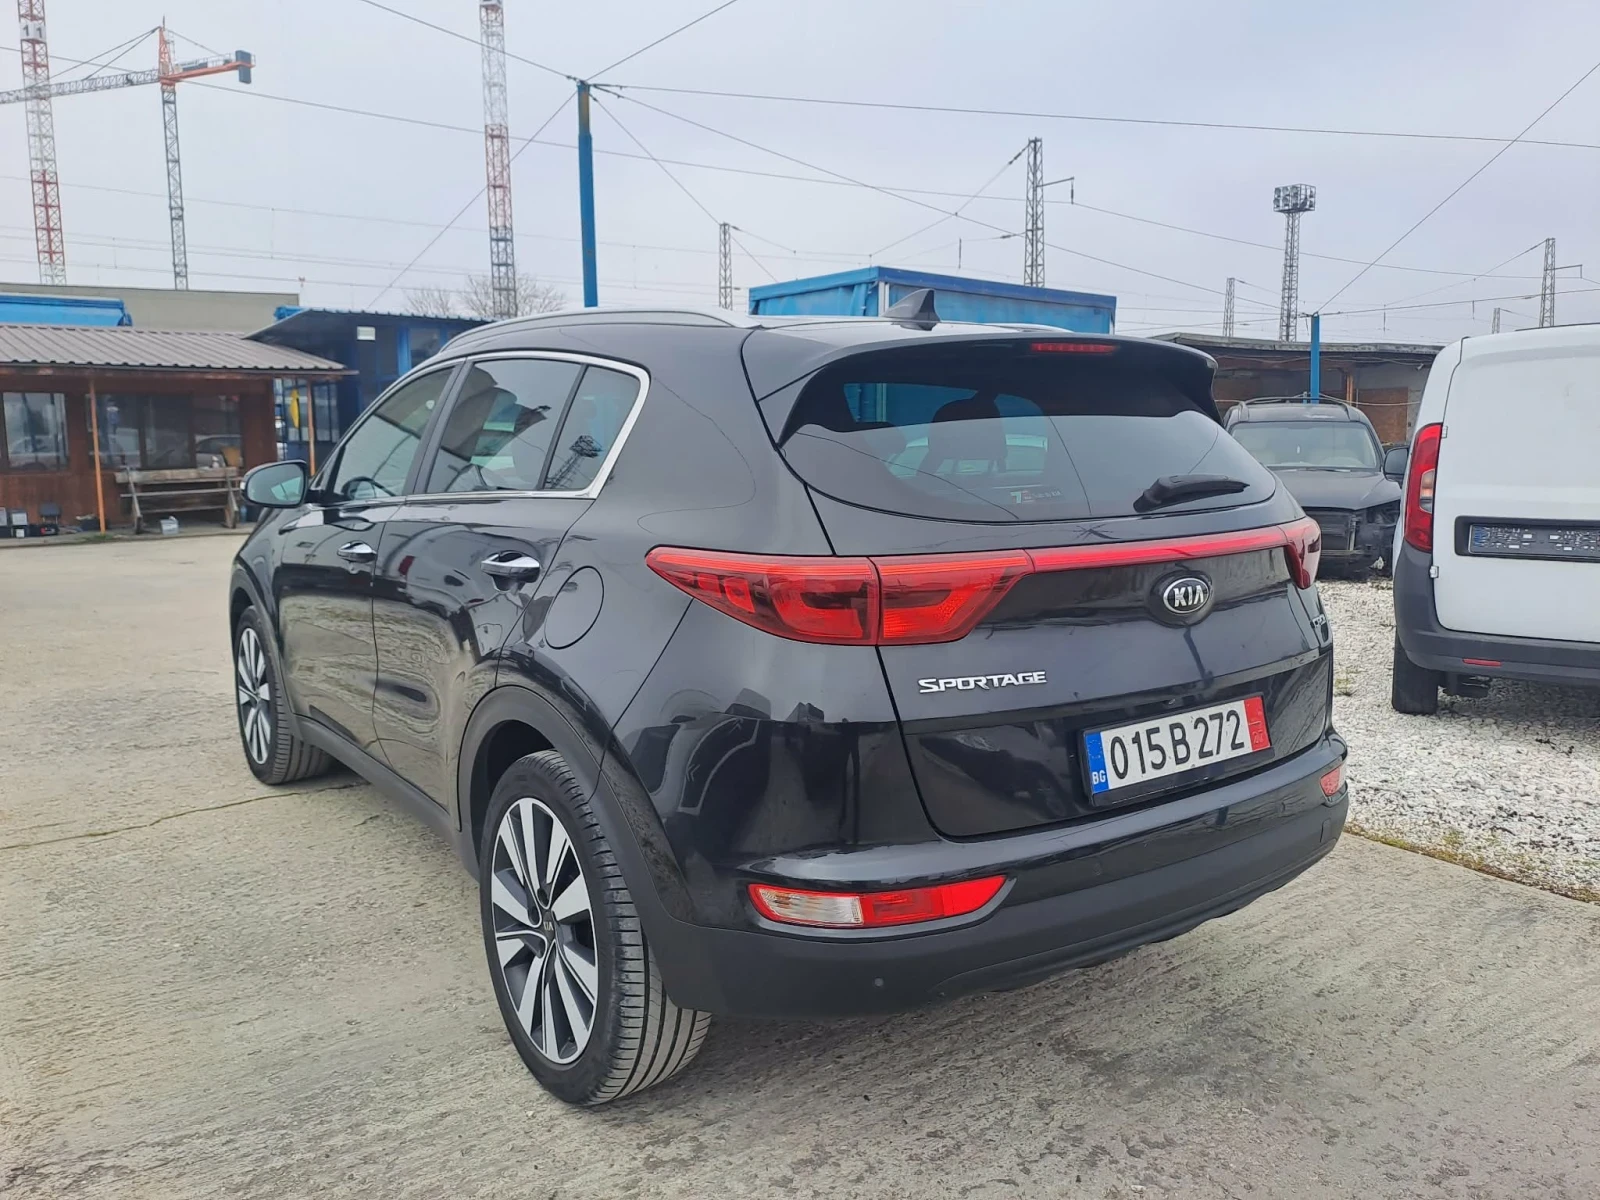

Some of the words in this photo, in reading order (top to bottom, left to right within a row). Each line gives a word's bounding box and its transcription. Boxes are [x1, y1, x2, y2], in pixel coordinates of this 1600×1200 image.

[1173, 584, 1204, 607] KIA
[918, 671, 1047, 694] SPORTAGE
[1092, 769, 1107, 785] BG
